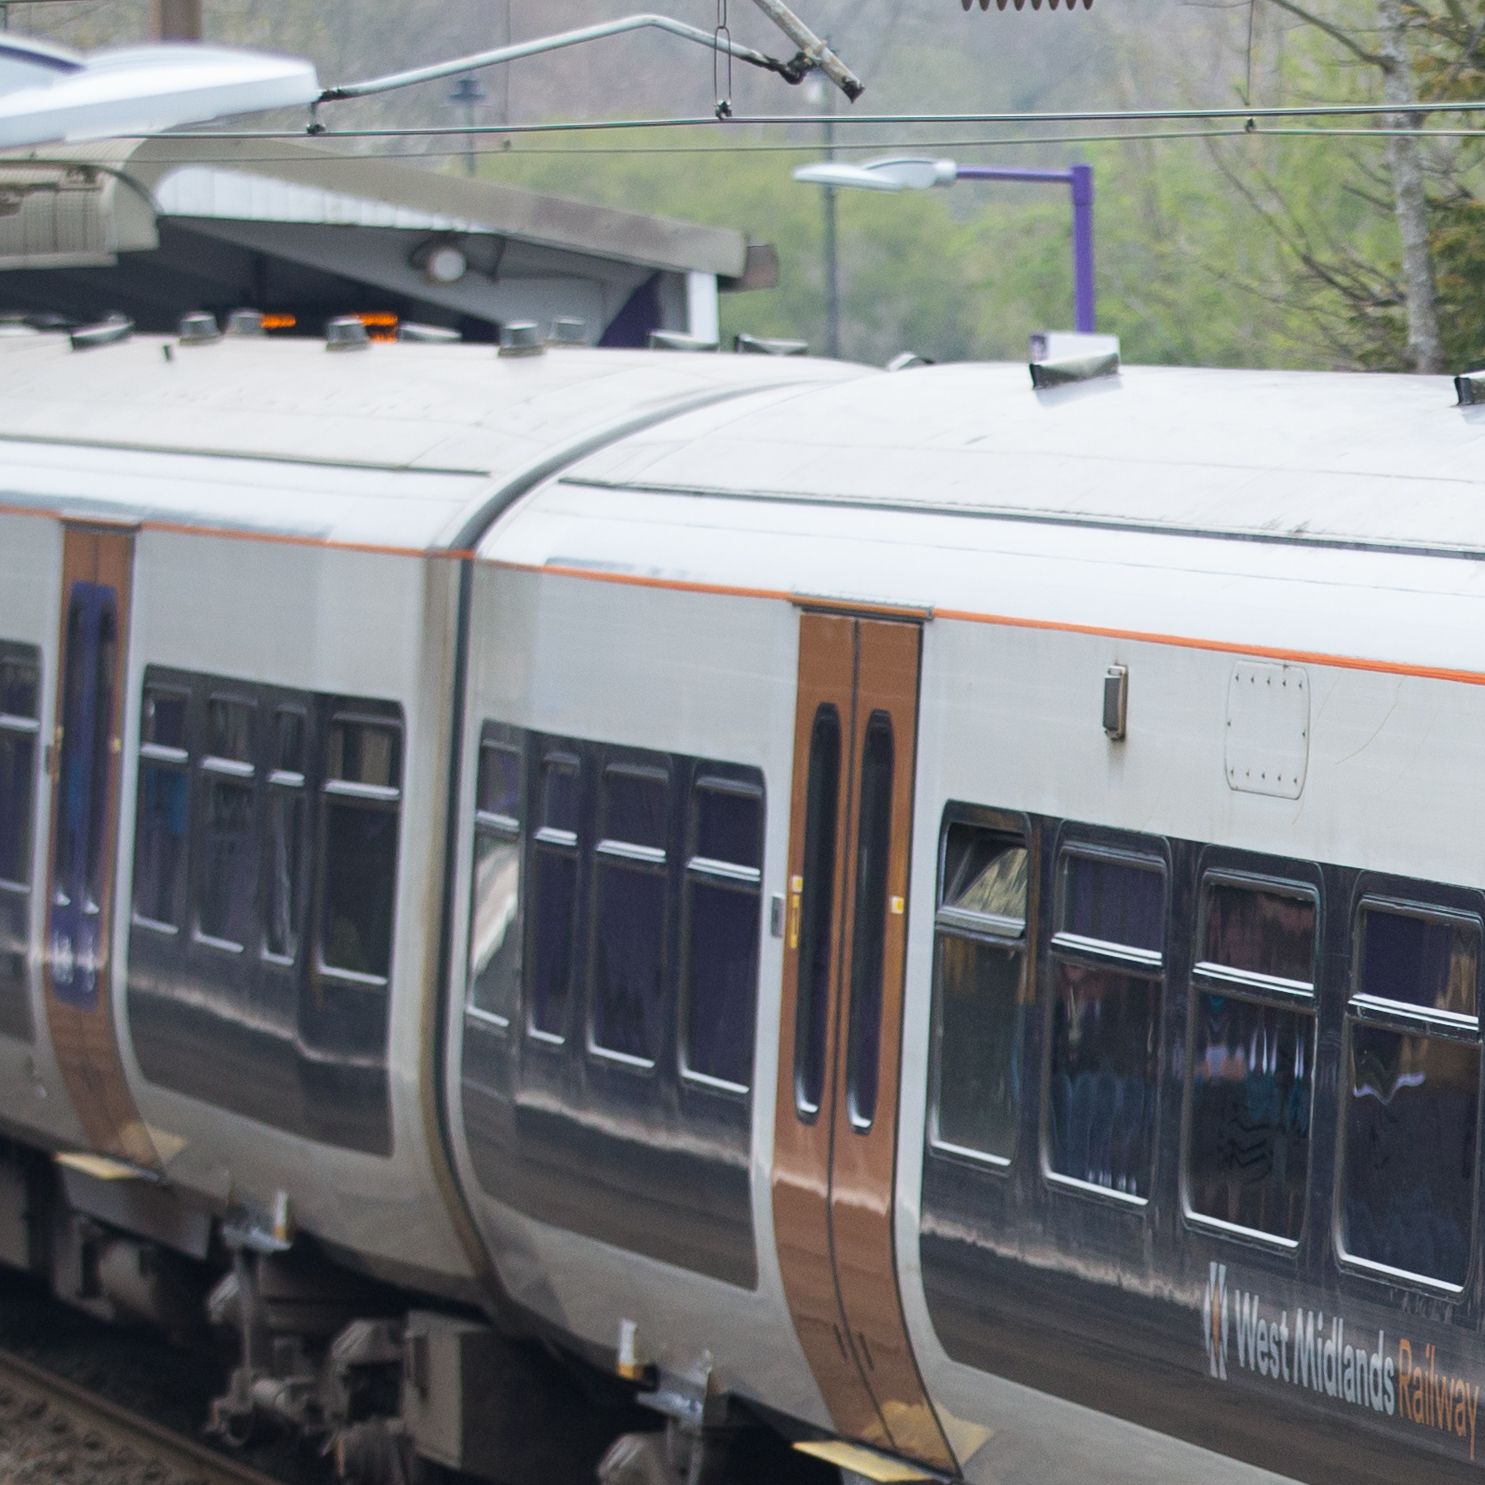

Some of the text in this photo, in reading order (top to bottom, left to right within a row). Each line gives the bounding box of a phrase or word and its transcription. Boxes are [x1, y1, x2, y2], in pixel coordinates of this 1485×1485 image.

[1235, 1289, 1480, 1461] West Midlands Railway
